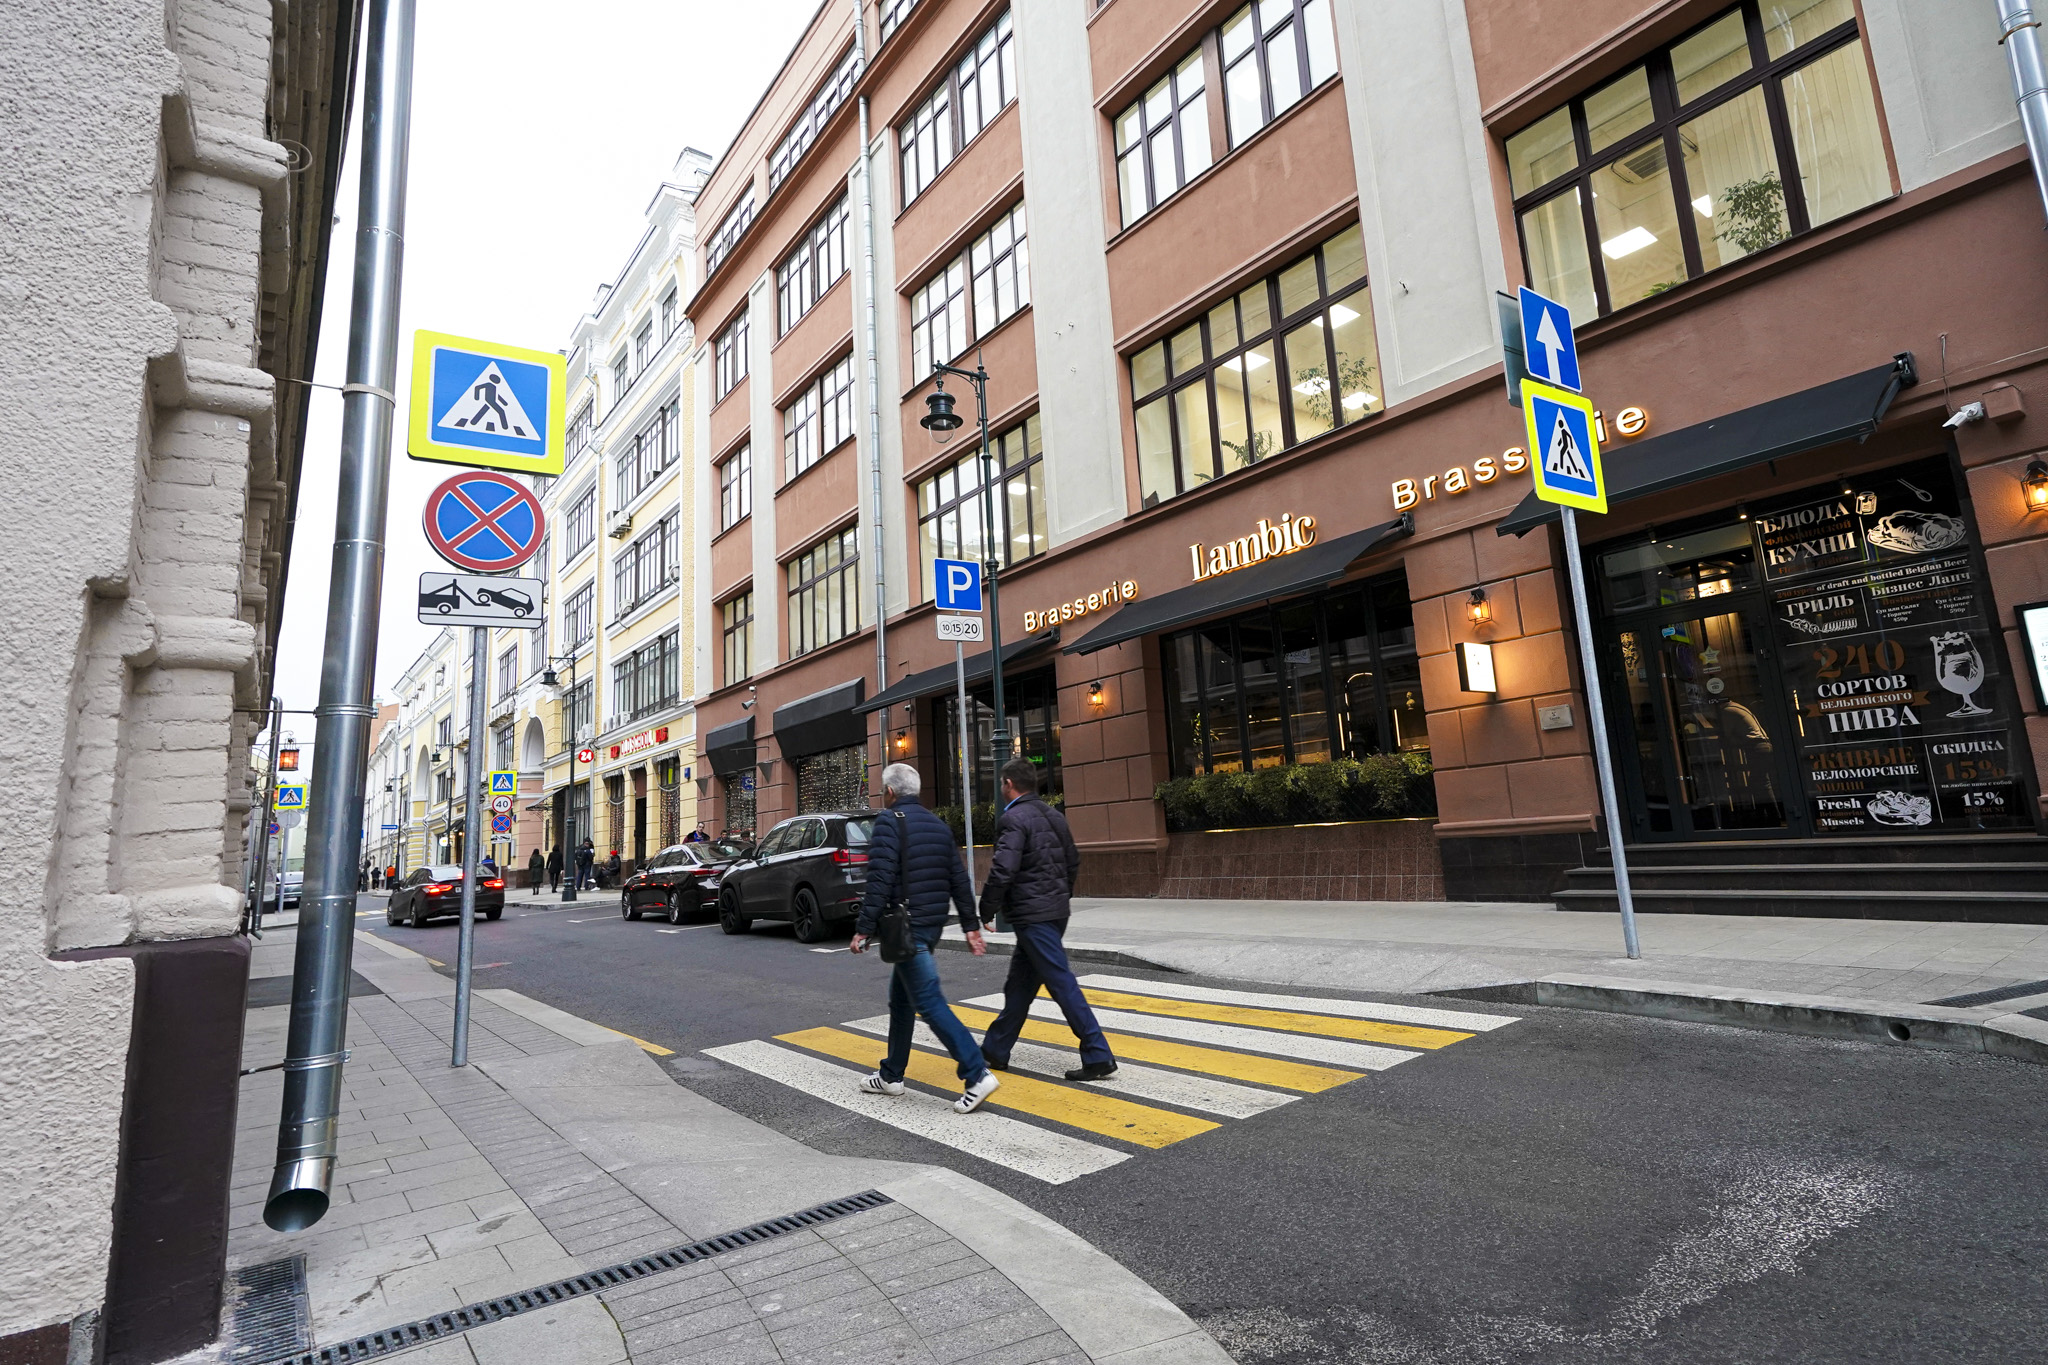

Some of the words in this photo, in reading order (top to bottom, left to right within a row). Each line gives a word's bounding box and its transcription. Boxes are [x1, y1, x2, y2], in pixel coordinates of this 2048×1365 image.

[1391, 406, 1648, 510] Brassie
[1763, 502, 1850, 534] БЛЮДА
[1188, 512, 1316, 582] Lambic
[1767, 531, 1857, 566] КУХНИ
[947, 565, 972, 604] P
[1816, 583, 1827, 592] of
[1827, 580, 1849, 590] draft
[1851, 576, 1869, 585] and
[1871, 567, 1904, 581] bottled
[1906, 562, 1942, 575] Belgian
[1944, 558, 1968, 570] Beer
[1871, 580, 1924, 596] Бизнес
[1929, 572, 1971, 586] Ланч
[1024, 579, 1137, 632] Brasserie
[1787, 594, 1854, 617] ГРИЛЬ
[952, 624, 961, 633] 15
[964, 623, 978, 634] 20
[1813, 640, 1905, 679] 240
[1817, 674, 1908, 698] СОРТОВ
[1820, 691, 1912, 710] БЕЛЬГИЙСКОГО
[1826, 705, 1922, 733] ПИВА
[581, 751, 592, 761] 24
[1809, 746, 1916, 770] ЖИВЫЕ
[1932, 740, 2004, 755] СКИДКА
[1811, 764, 1919, 781] БЕЛОМОРСКИЕ
[1945, 759, 2006, 780] 15%
[495, 800, 509, 808] 40
[1817, 797, 1862, 811] Fresh
[1961, 791, 2005, 807] 15%
[1821, 817, 1865, 827] Mussels
